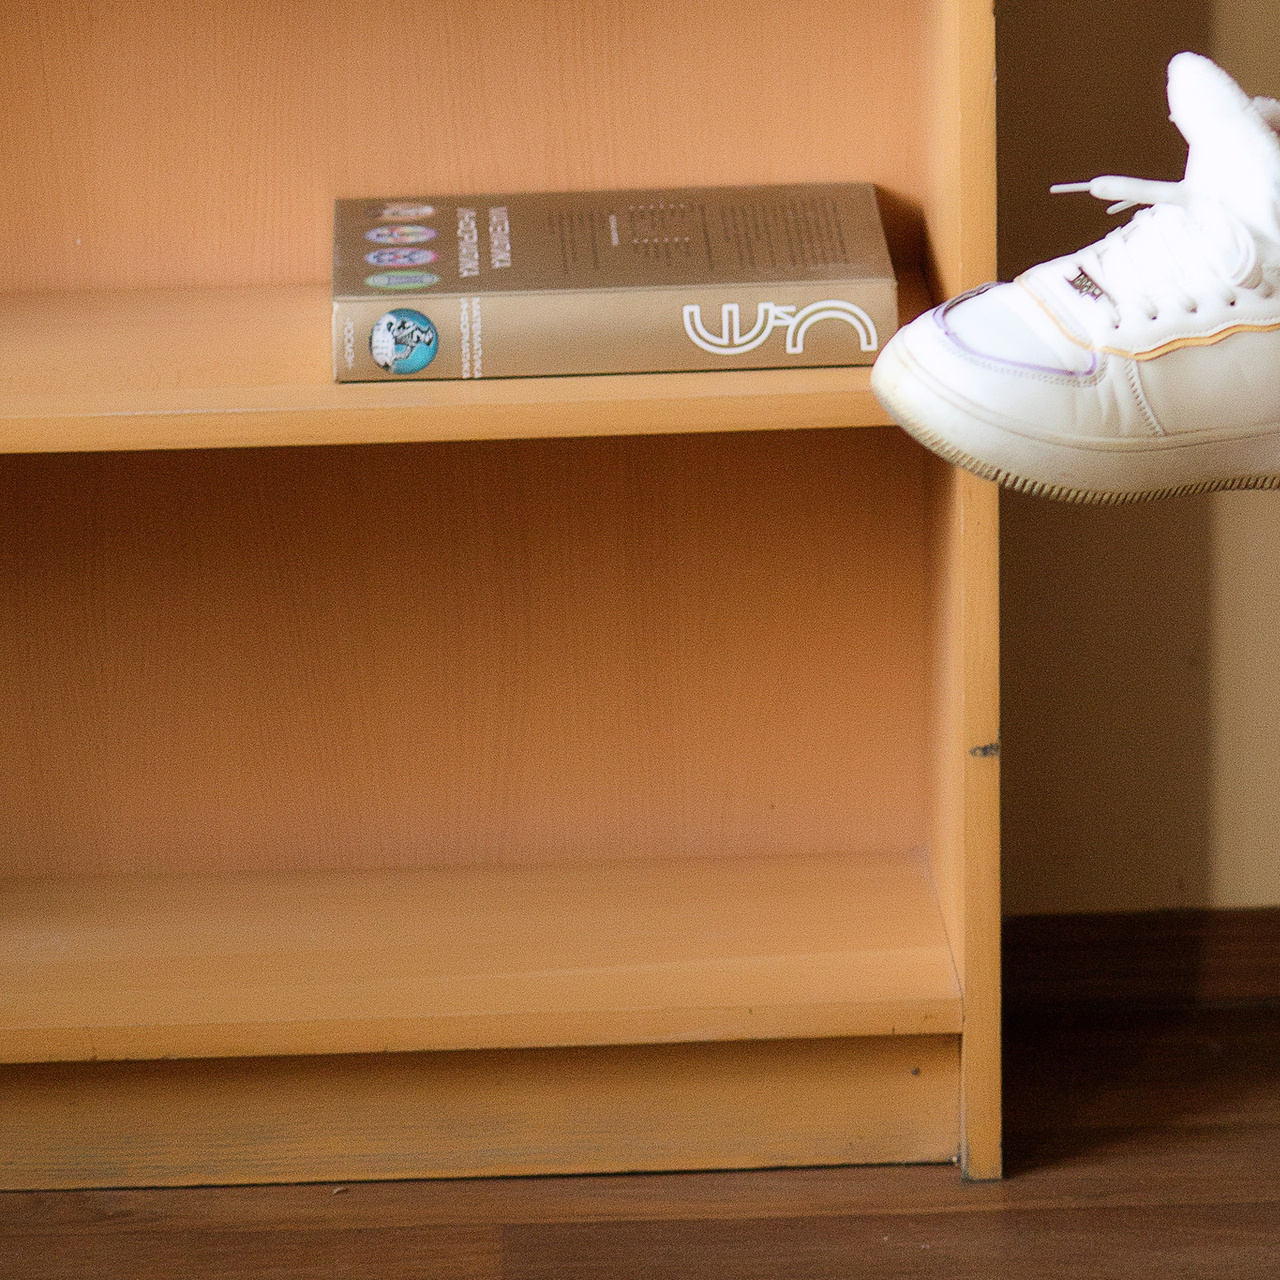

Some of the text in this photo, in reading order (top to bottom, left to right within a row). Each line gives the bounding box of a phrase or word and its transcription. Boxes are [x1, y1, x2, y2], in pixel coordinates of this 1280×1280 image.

[456, 207, 480, 278] ИНФОРМАТИКА
[488, 206, 511, 269] МАТЕМАТИКА
[472, 297, 482, 378] МАТЕМАТИКА
